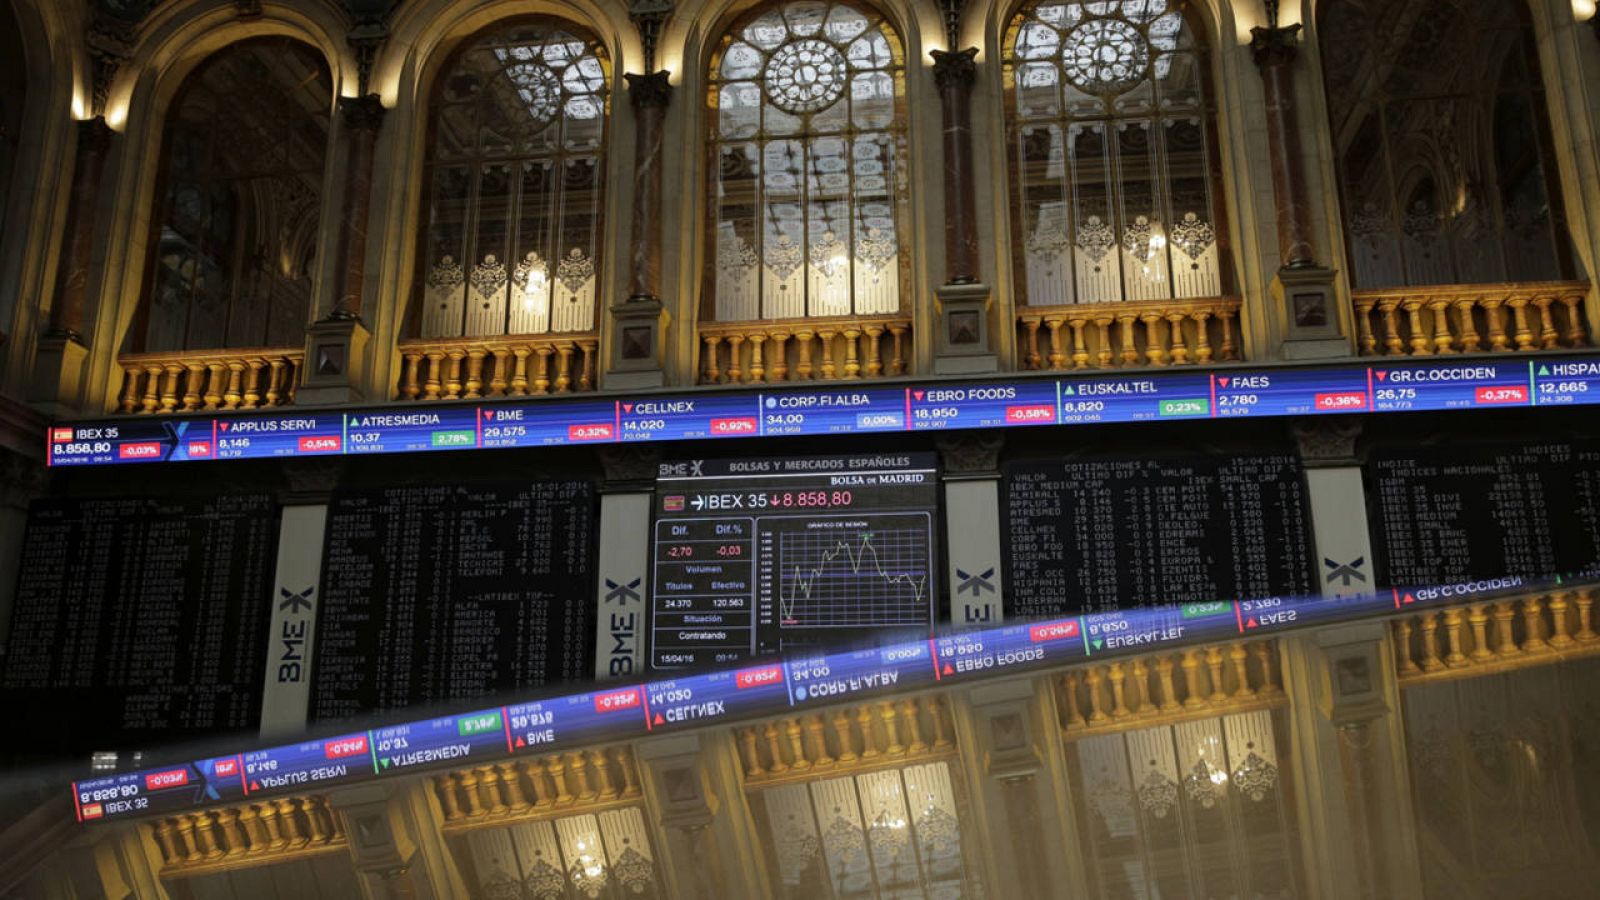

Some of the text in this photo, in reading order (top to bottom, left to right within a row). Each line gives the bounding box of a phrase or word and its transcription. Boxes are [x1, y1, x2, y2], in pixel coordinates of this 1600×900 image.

[1390, 367, 1496, 382] GR.C.OCCIDEN
[1553, 363, 1600, 376] HISPA
[1232, 376, 1270, 389] FAES
[1539, 382, 1588, 394] 12,665
[927, 388, 1016, 402] EBRO FOODS
[1078, 382, 1158, 396] EUSKALTEL
[1376, 389, 1416, 400] 26,75
[780, 394, 870, 408] CORP.FI.ALBA
[1219, 394, 1258, 406] 2,780
[1480, 390, 1522, 401] -0,37%
[635, 402, 694, 414] CELLNEX
[1065, 401, 1104, 412] 8,820
[1166, 402, 1200, 412] 0,23%
[497, 410, 523, 421] BME
[915, 408, 958, 420] 18,950
[1010, 408, 1050, 419] -0,58%
[231, 420, 316, 432] APPLUS SERVI
[362, 414, 440, 427] ATRESMEDIA
[624, 419, 665, 431] 14,020
[766, 414, 804, 426] 34,00
[864, 416, 896, 425] 0,00%
[484, 426, 526, 438] 29,575
[573, 427, 610, 438] -0,32%
[714, 422, 752, 432] -0,92%
[76, 428, 118, 440] IBEX 35
[350, 432, 380, 444] 10,37
[438, 432, 468, 444] 2,78%
[54, 442, 111, 455] 8.858,80
[219, 438, 250, 450] 8,146
[302, 439, 337, 450] -0,54%
[125, 445, 157, 456] -0,03%
[729, 462, 770, 472] BOLSAS
[774, 462, 781, 470] Y
[784, 459, 844, 470] MERCADOS
[848, 456, 910, 468] ESPAÑOLES
[831, 476, 864, 486] BOLSA
[879, 474, 924, 484] MADRID
[704, 491, 852, 508] IBEX 35 8.858,80
[672, 524, 742, 535] Dif. Dif.%
[686, 565, 722, 574] Volumen
[712, 581, 744, 590] Efectivo
[679, 631, 726, 640] Contratando
[610, 612, 634, 677] BME
[278, 620, 306, 683] BME
